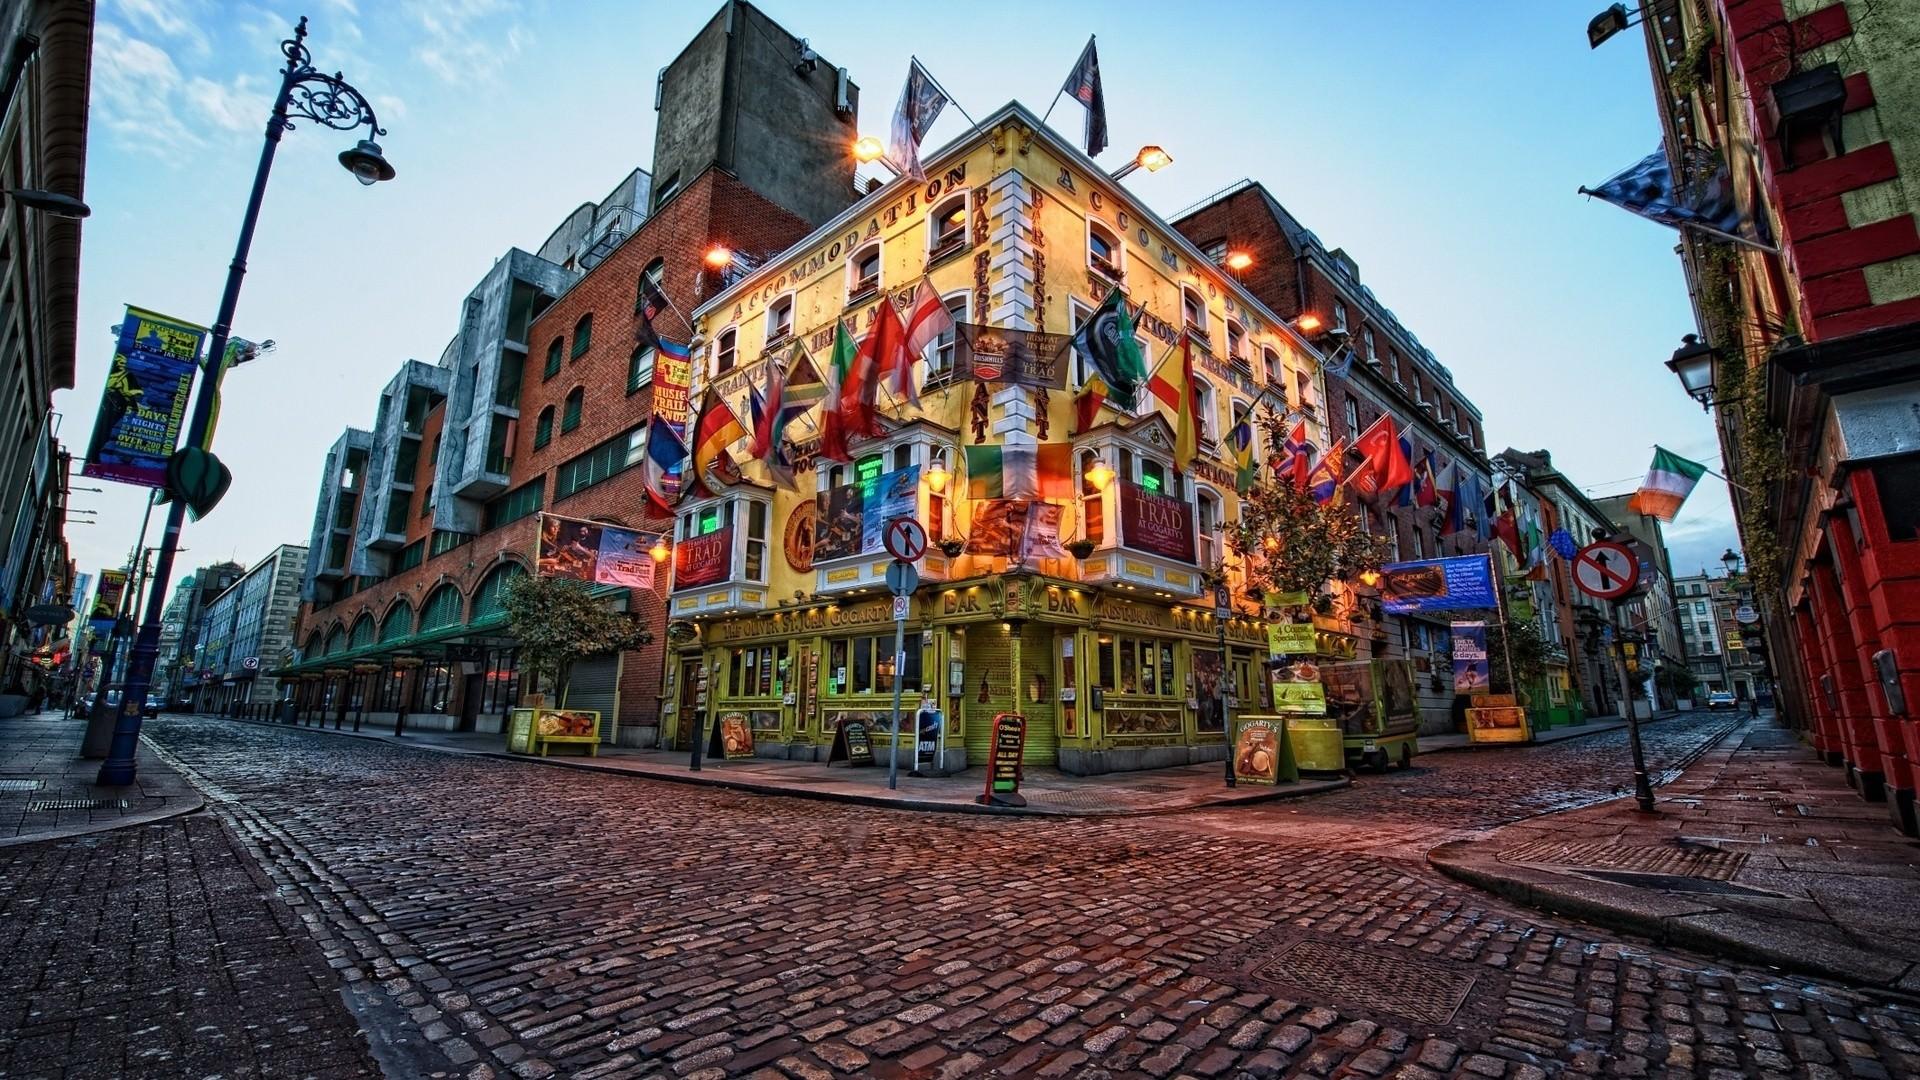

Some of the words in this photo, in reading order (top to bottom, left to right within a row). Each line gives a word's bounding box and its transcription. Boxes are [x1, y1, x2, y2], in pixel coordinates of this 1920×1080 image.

[973, 187, 990, 248] BAR
[1030, 186, 1045, 248] BAR
[731, 161, 969, 322] ACCOMMODATION
[168, 334, 195, 349] Trad
[973, 354, 1004, 365] BUSHMILLS
[1023, 365, 1056, 377] TRAD
[655, 385, 686, 399] MUSIC
[653, 396, 686, 412] TRAIL
[125, 406, 132, 415] 5
[137, 407, 169, 423] DAYS
[131, 418, 166, 432] NIGHTS
[117, 434, 143, 446] OVER
[145, 440, 161, 449] 200
[1136, 488, 1165, 506] TEMPLE
[1167, 501, 1182, 512] BAR
[1136, 497, 1183, 530] TRAD
[1138, 521, 1146, 529] AT
[686, 541, 722, 564] TRAD
[943, 591, 982, 615] BAR
[1047, 588, 1080, 615] BAR
[723, 622, 741, 639] THE
[743, 620, 780, 638] OLIVER
[799, 613, 827, 632] JOHN
[828, 604, 893, 627] GOGARTY
[1099, 600, 1162, 628] RESTAURANT
[1272, 632, 1297, 643] Special
[918, 740, 936, 752] ATM
[997, 751, 1007, 759] ALL
[1008, 751, 1019, 759] DAY
